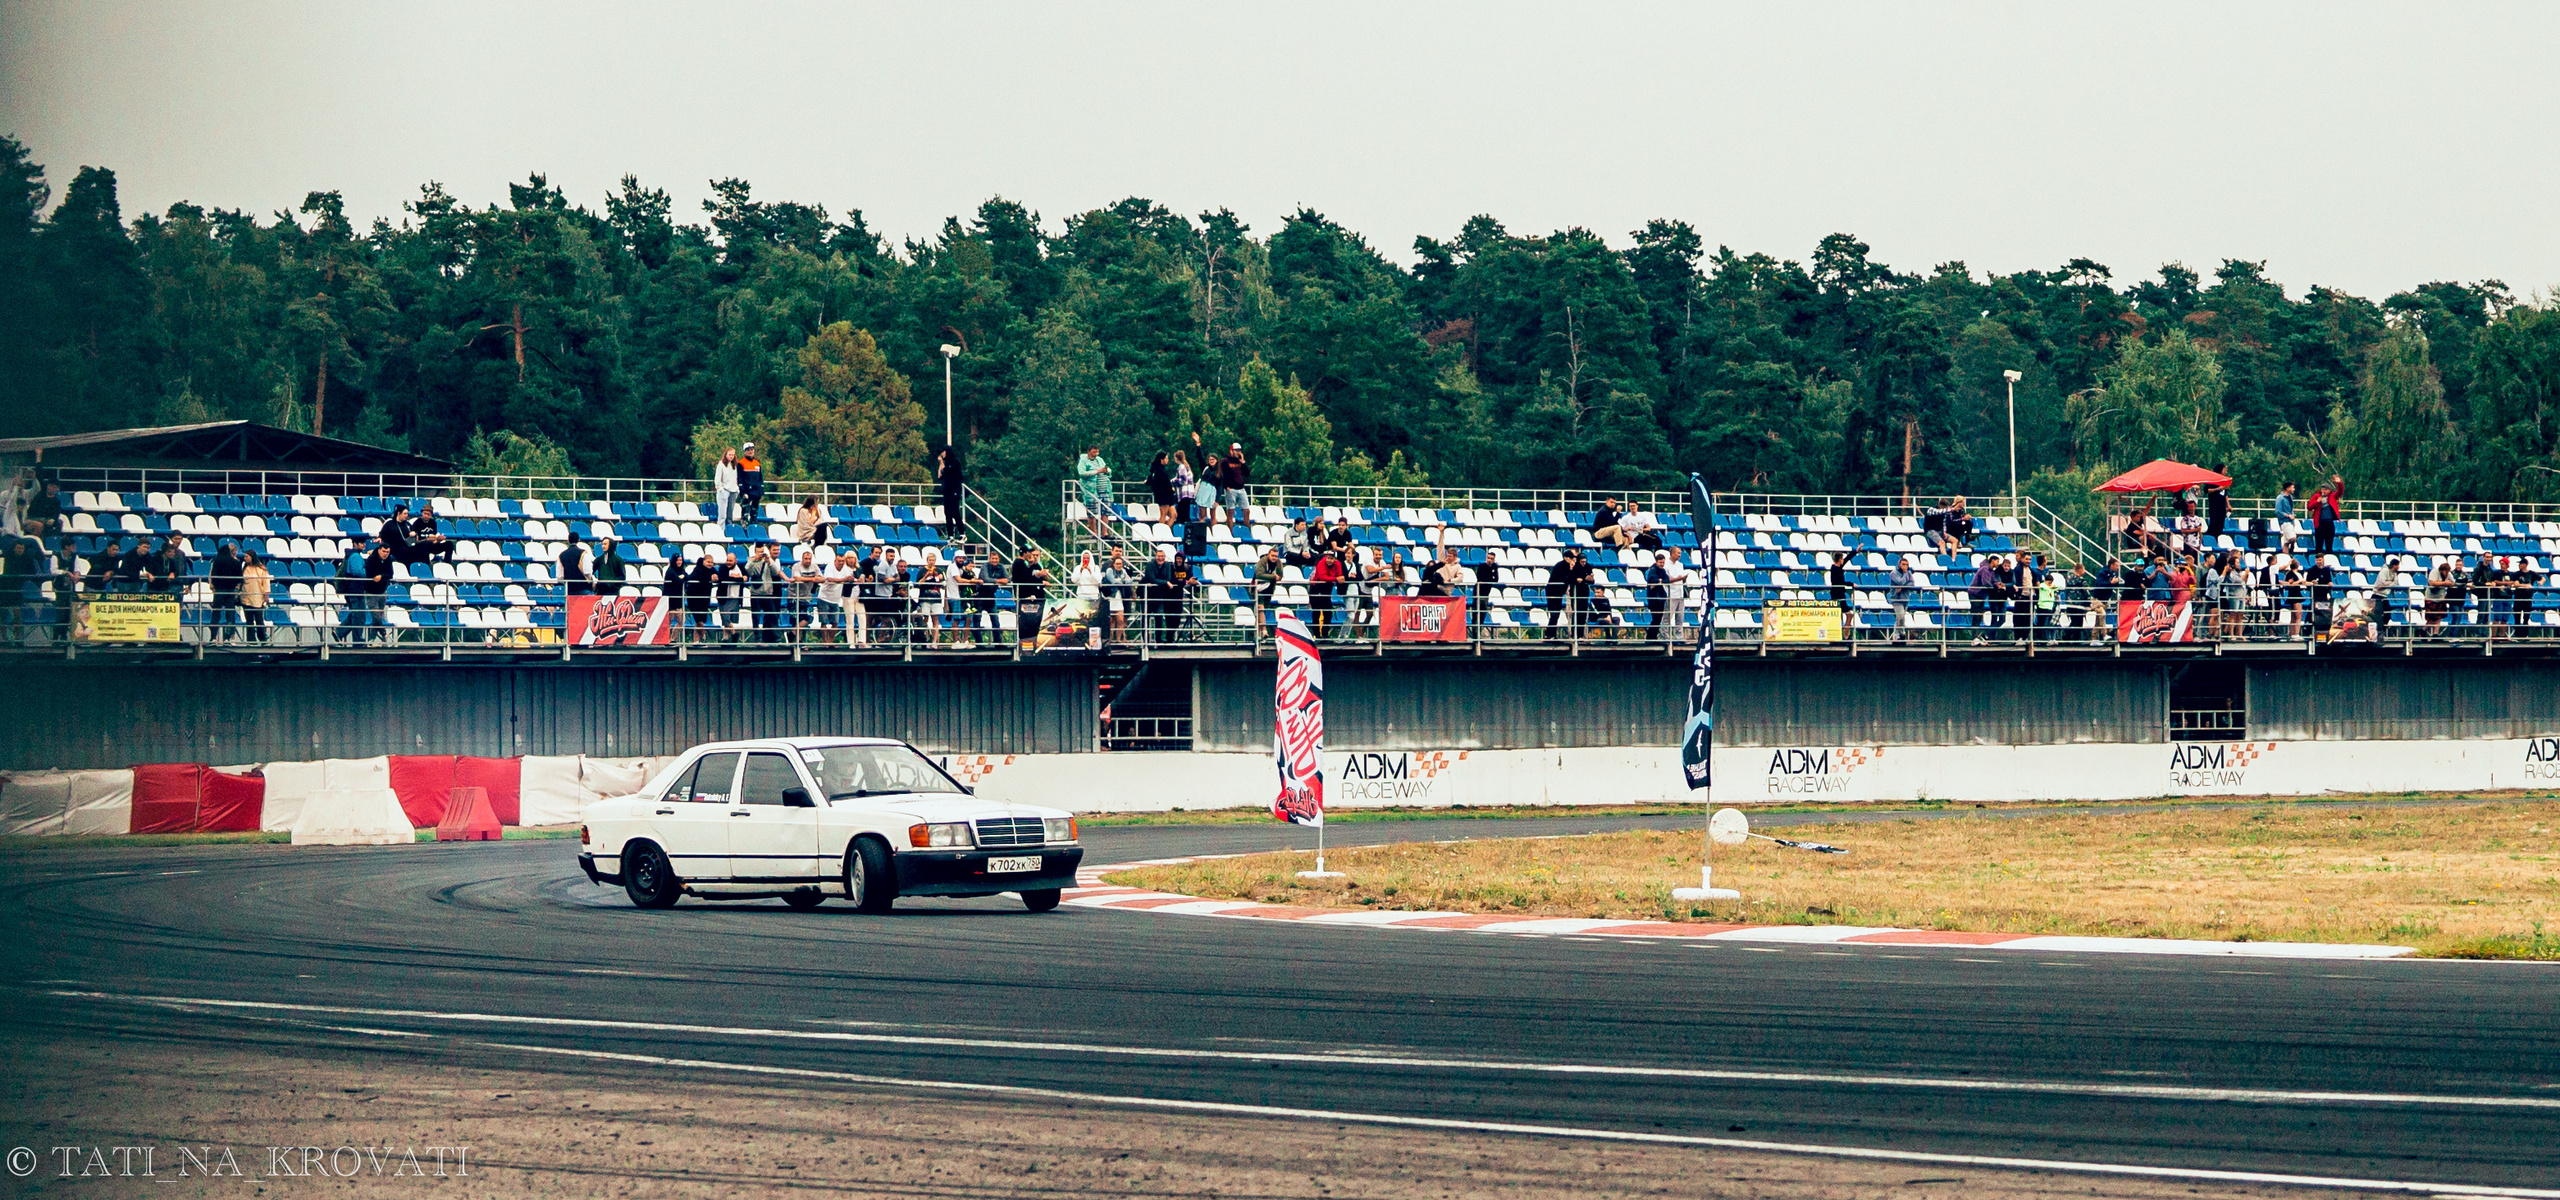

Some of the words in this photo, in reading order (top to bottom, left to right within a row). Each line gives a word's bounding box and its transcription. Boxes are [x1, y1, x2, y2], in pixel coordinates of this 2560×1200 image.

[1402, 605, 1421, 631] NO
[1422, 605, 1446, 618] DRIFT
[1422, 619, 1440, 631] FUN
[1343, 753, 1407, 779] ADM
[1769, 749, 1828, 774] ADM
[2170, 743, 2224, 770] ADM
[1768, 776, 1851, 793] RACEWAY
[2170, 770, 2245, 787] RACEWAY
[1342, 780, 1433, 799] RACEWAY
